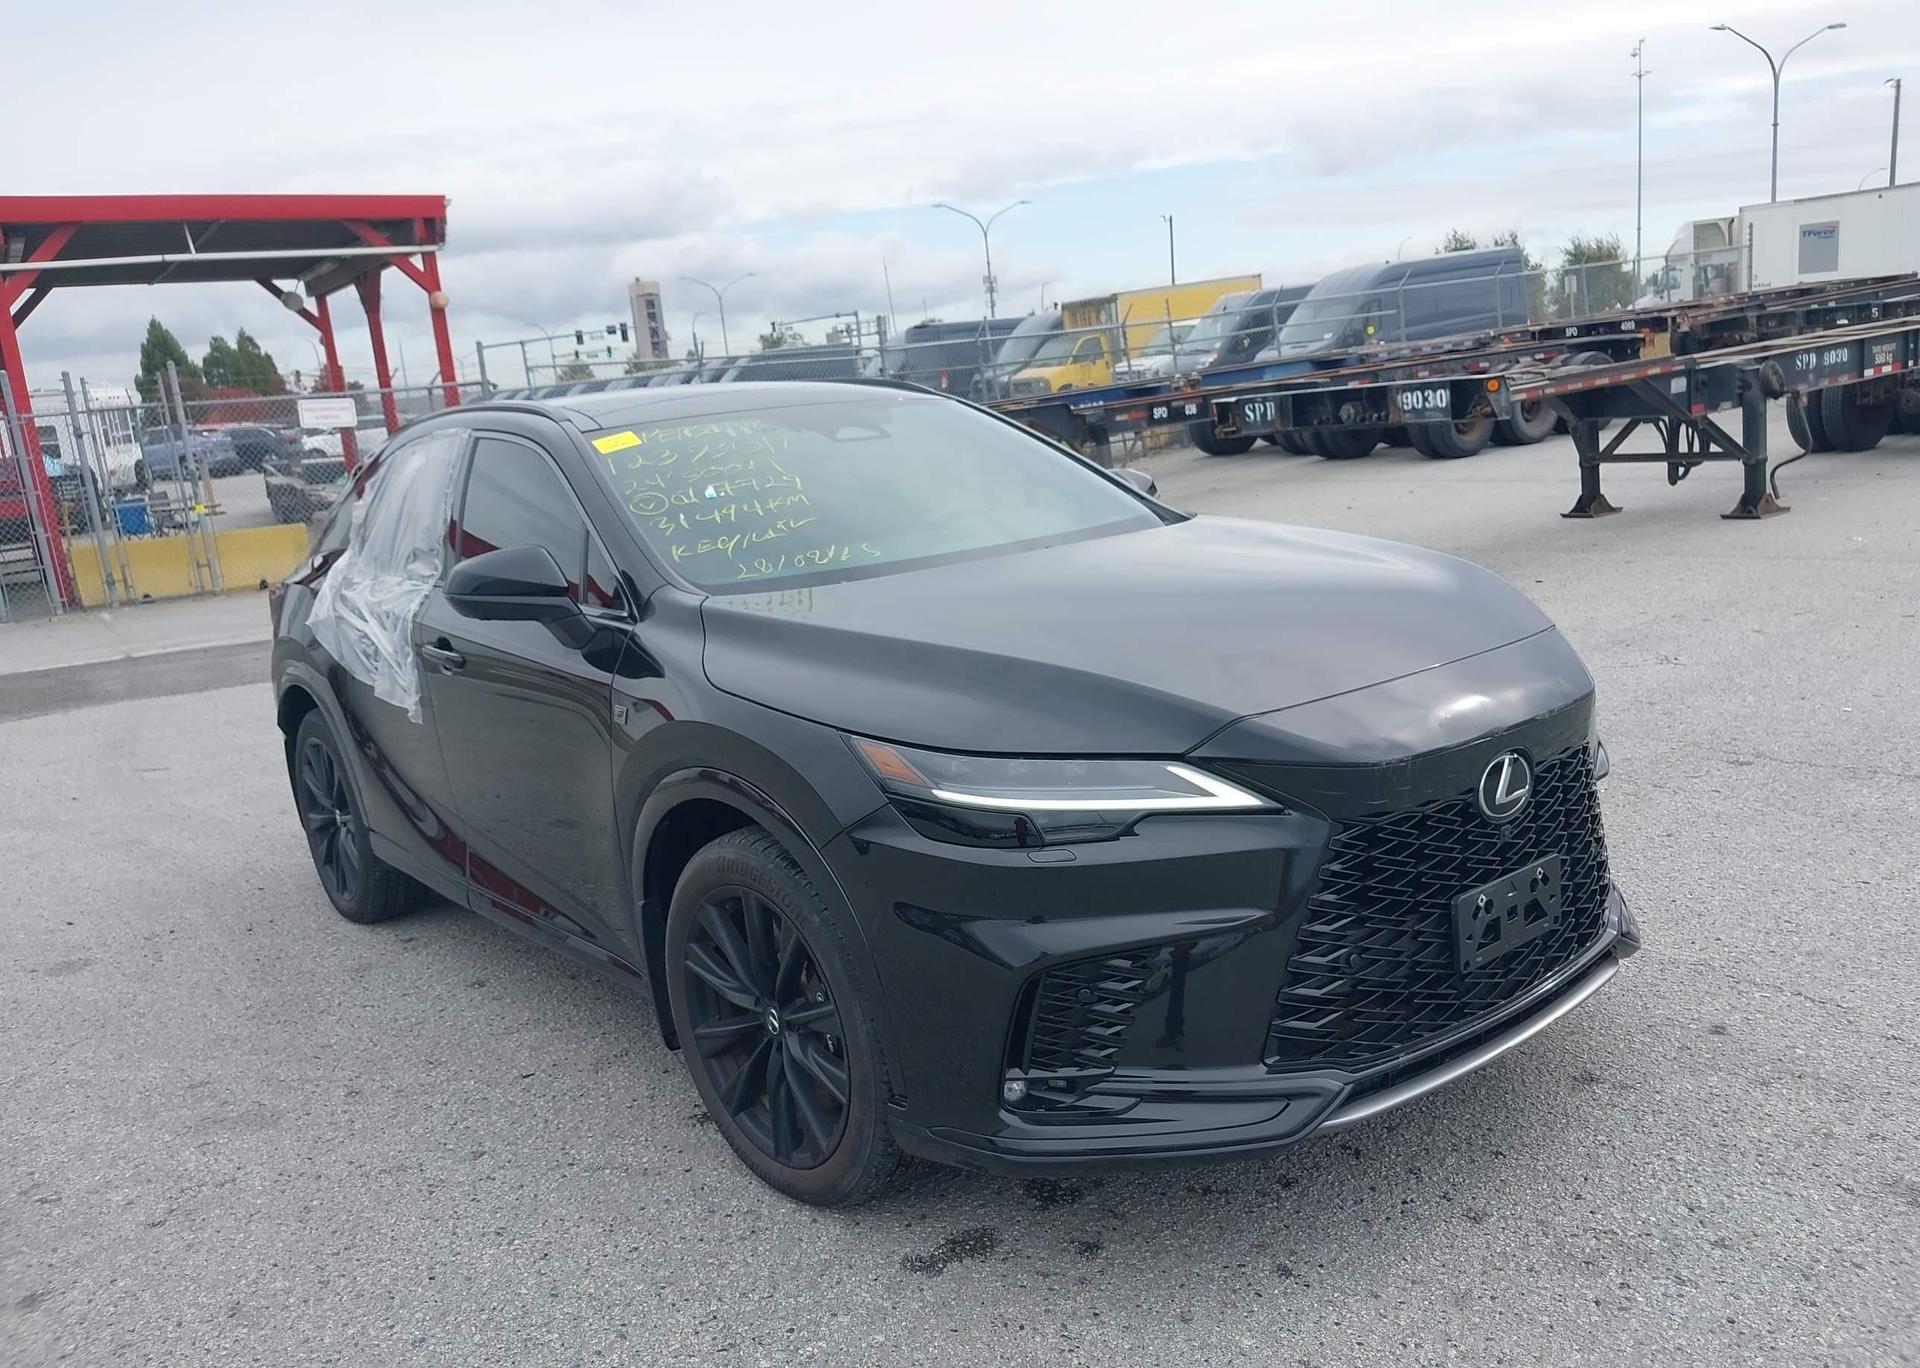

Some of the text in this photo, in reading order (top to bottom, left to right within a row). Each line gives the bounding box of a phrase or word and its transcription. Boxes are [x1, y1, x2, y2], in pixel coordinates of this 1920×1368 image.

[1802, 229, 1836, 238] TForce
[1796, 351, 1817, 370] SPD
[1244, 388, 1448, 422] SPD 9030
